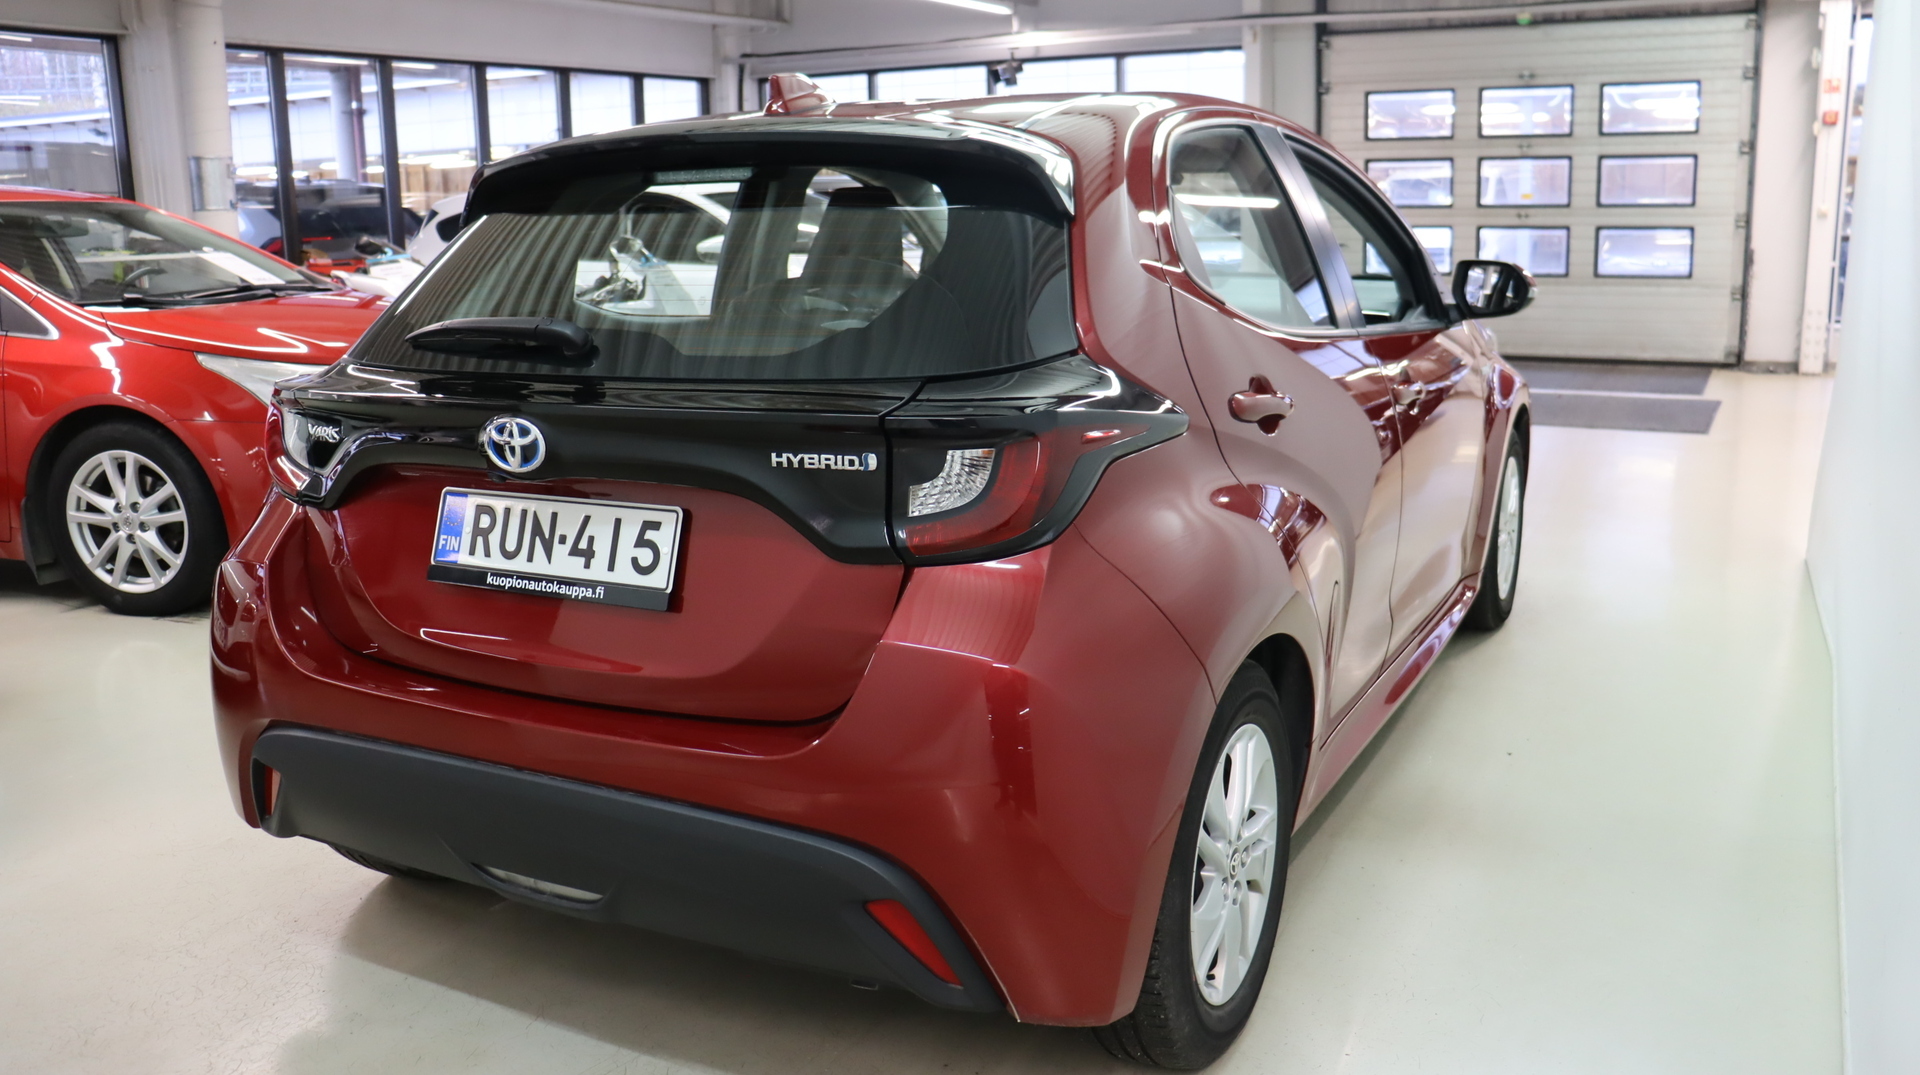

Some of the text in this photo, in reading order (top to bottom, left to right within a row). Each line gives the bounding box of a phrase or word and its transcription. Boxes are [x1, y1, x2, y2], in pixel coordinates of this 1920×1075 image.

[771, 452, 860, 471] HYBRID
[439, 534, 460, 551] FIN
[486, 572, 604, 599] kuopionautokauppa.fi
